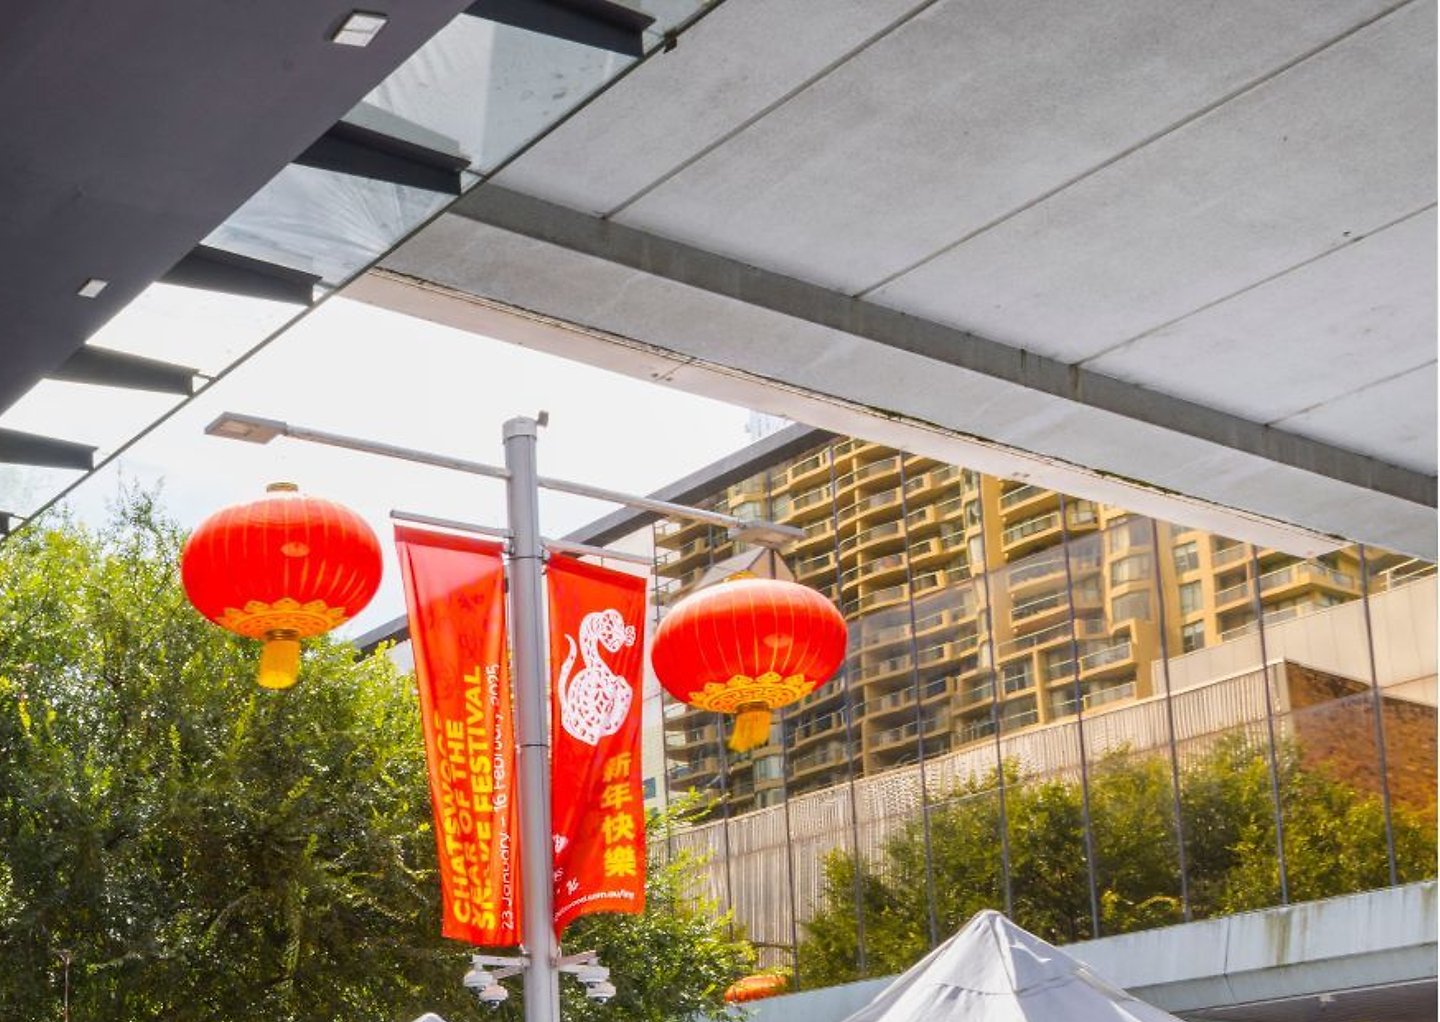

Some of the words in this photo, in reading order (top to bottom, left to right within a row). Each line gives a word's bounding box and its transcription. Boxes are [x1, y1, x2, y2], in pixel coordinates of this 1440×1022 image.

[446, 719, 467, 781] THE
[464, 666, 493, 812] FESTIVAL
[455, 789, 472, 833] OF
[493, 793, 508, 812] 16
[601, 752, 637, 877] 新年快樂
[500, 832, 513, 906] January
[502, 910, 514, 930] 23
